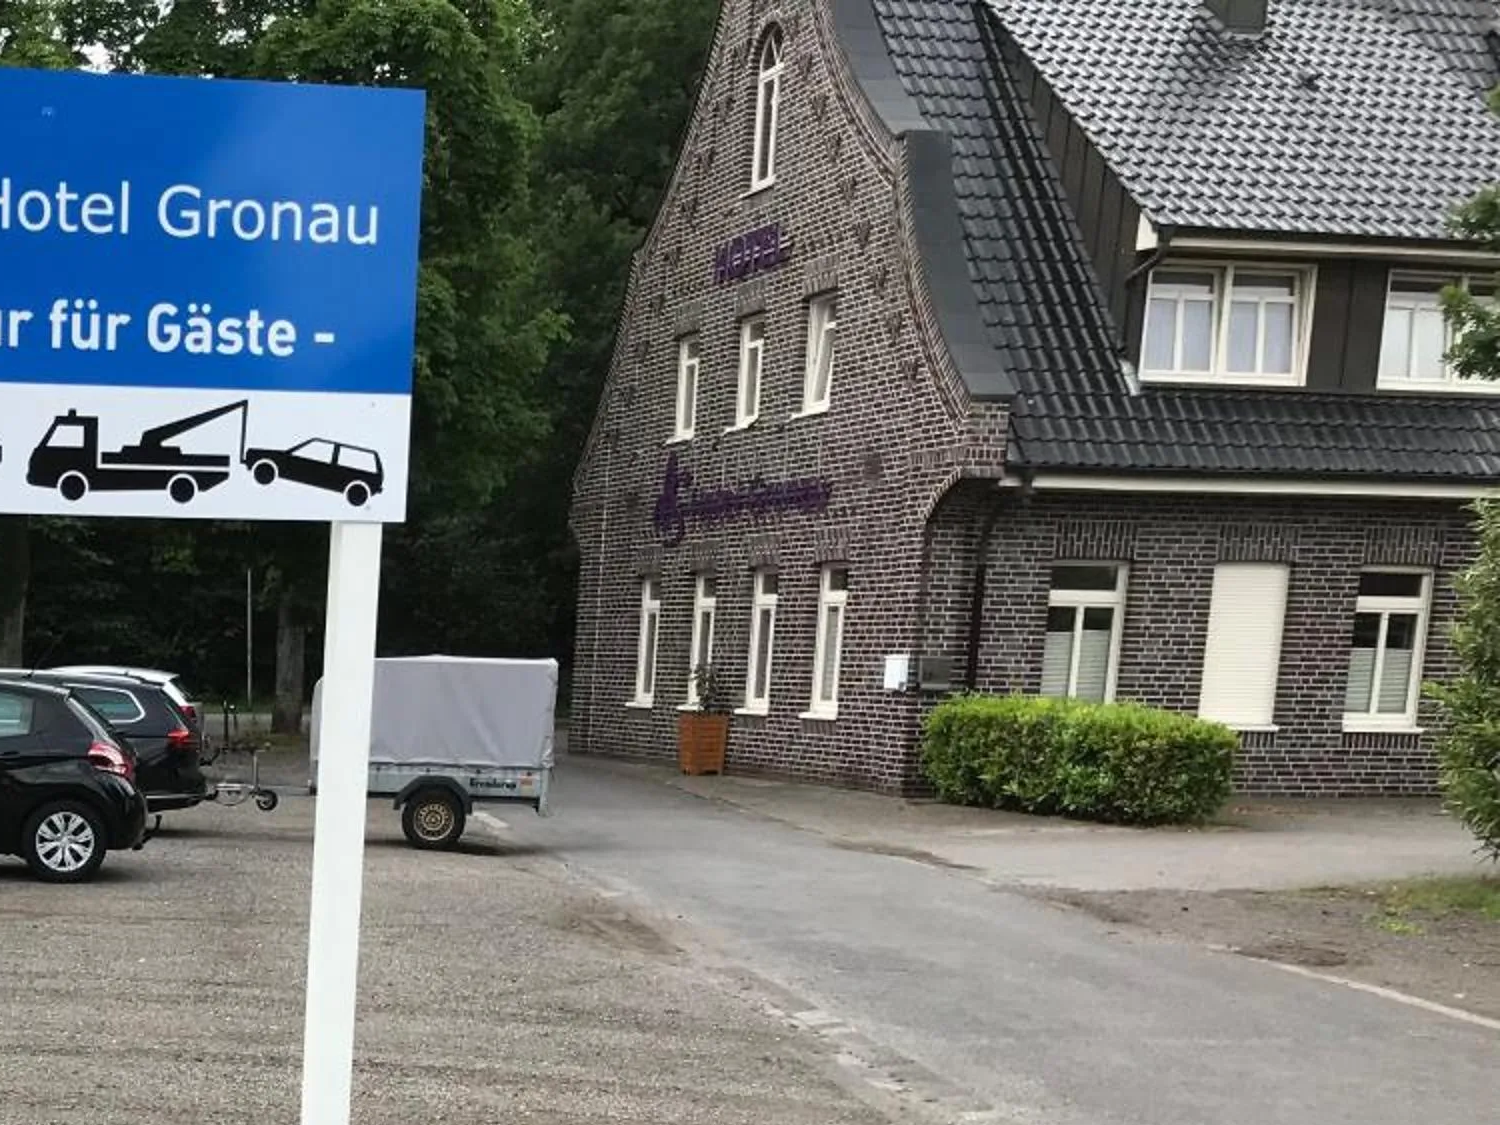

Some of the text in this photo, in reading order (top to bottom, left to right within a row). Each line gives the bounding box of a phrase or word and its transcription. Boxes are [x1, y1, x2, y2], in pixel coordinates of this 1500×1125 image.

[158, 185, 378, 245] Gronau
[49, 299, 131, 350] für
[147, 303, 296, 357] Gäste
